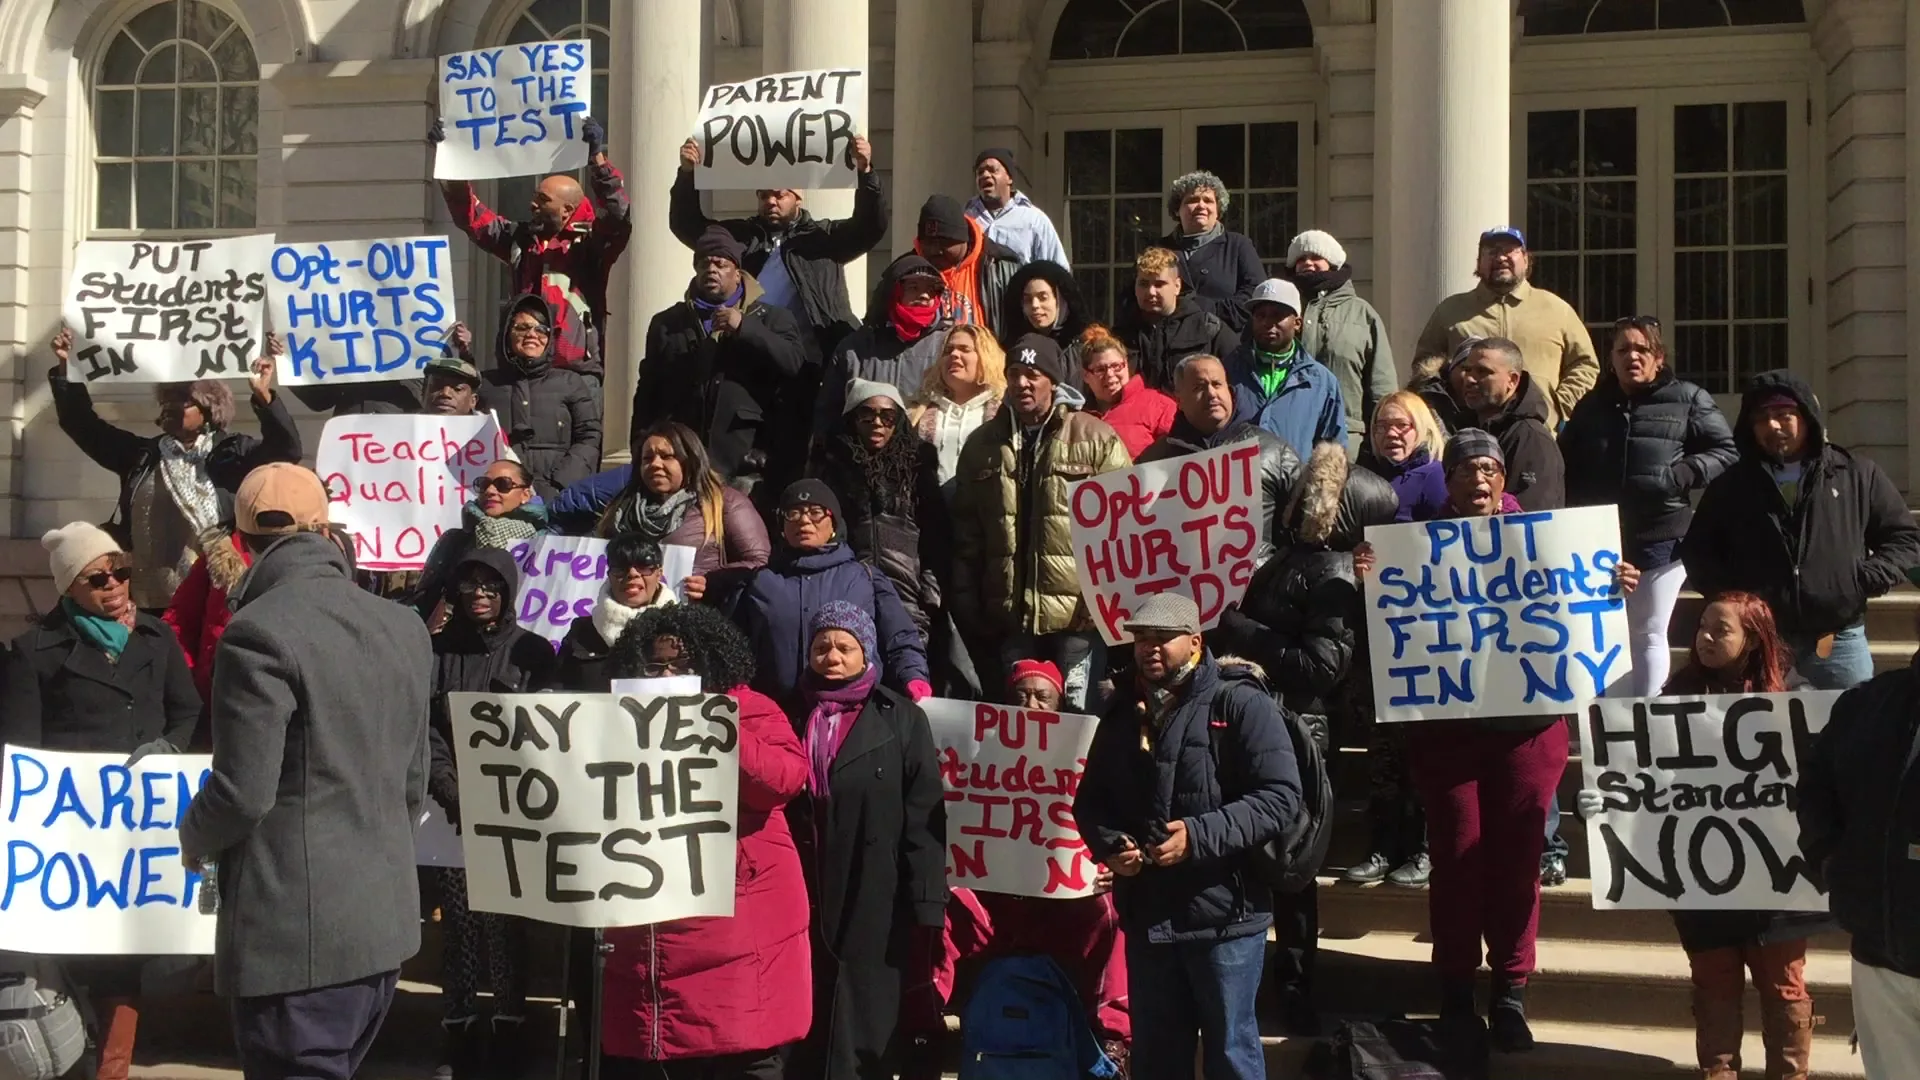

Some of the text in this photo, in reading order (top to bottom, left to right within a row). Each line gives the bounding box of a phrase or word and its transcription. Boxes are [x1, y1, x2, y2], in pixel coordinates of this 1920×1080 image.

[445, 43, 585, 83] SAY YES
[456, 76, 576, 113] TO THE
[708, 71, 862, 109] PARENT
[456, 102, 587, 151] TEST
[703, 108, 856, 171] POWER
[129, 242, 213, 274] PUT
[271, 240, 448, 291] Opt-OUT
[76, 269, 265, 307] Students
[287, 283, 445, 329] HURTS
[76, 338, 257, 381] IN NY
[287, 325, 449, 380] KIDS
[328, 466, 473, 508] Qualit
[1072, 445, 1260, 541] Opt-OUT
[355, 524, 442, 559] NO
[1085, 504, 1257, 586] HURTS
[1425, 512, 1552, 565] PUT
[1377, 549, 1622, 609] Students
[1385, 598, 1625, 660] FIRST
[1388, 644, 1622, 706] IN NY
[469, 693, 738, 755] SAY YES
[974, 703, 1060, 751] PUT
[8, 753, 214, 831] PAREN
[480, 758, 723, 821] TO THE
[936, 746, 1088, 797] tuden
[1597, 771, 1799, 813] Standar
[944, 791, 1087, 850] IRS
[474, 820, 731, 903] TEST
[944, 840, 1093, 893] N N
[1600, 815, 1830, 903] NOW
